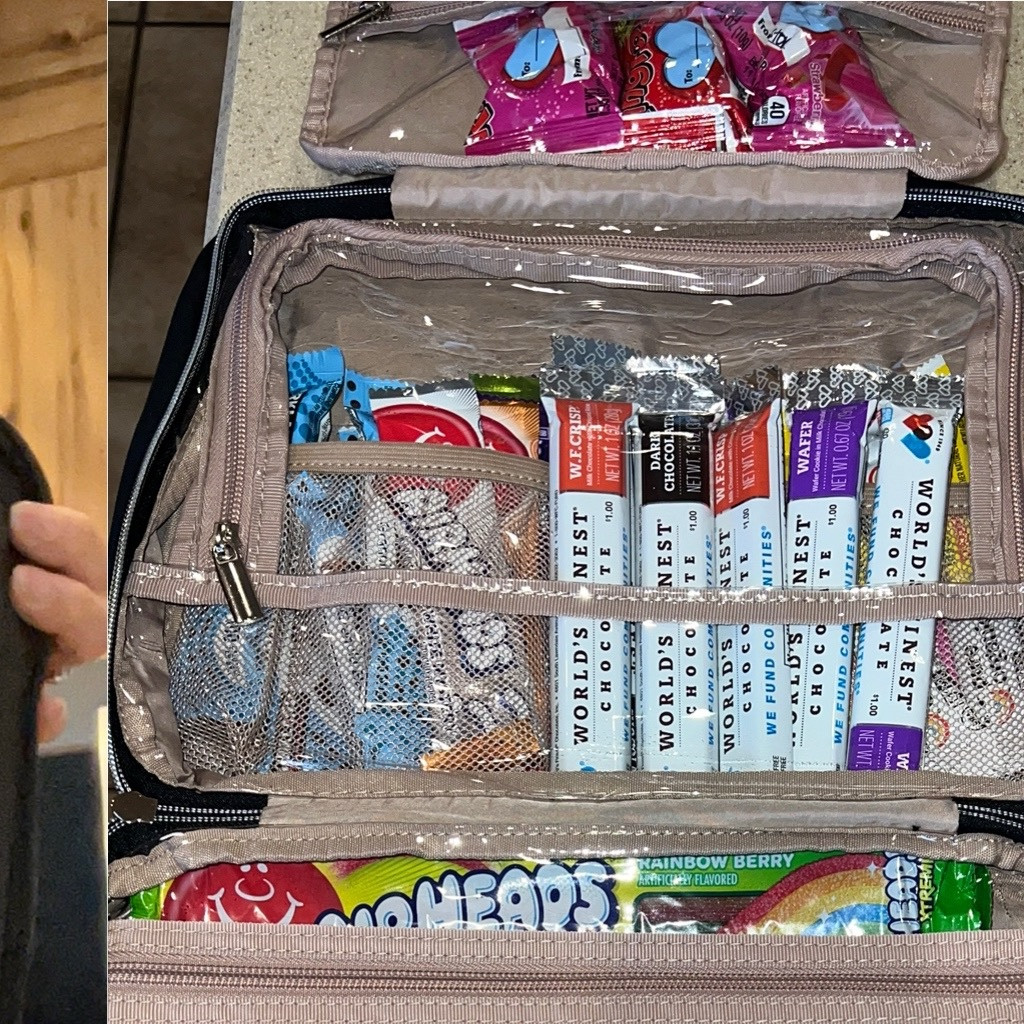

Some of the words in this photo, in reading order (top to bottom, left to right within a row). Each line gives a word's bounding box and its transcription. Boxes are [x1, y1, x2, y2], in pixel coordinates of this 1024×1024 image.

[757, 18, 773, 41] Fro
[522, 62, 531, 76] To:
[684, 69, 693, 84] To:
[809, 63, 822, 125] Strawberr
[769, 102, 784, 119] 40
[836, 420, 851, 431] OZ
[569, 405, 582, 480] W.F.CRISP
[797, 421, 813, 475] WAFER
[813, 452, 821, 473] Cookie
[605, 465, 620, 482] NET
[686, 476, 701, 492] NET
[741, 472, 755, 490] NET
[831, 475, 846, 491] NET
[605, 501, 613, 522] $1.00
[828, 504, 837, 525] $1.00
[911, 479, 933, 585] WORLD'
[897, 620, 920, 706] INEST
[573, 628, 589, 745] WORLD'S
[765, 659, 776, 703] FUND
[836, 665, 848, 712] FUND
[659, 636, 674, 752] WORLD'S
[721, 639, 735, 753] WORLD'S
[869, 695, 879, 716] $1.00
[765, 712, 776, 735] WE
[834, 720, 843, 744] WE
[858, 730, 874, 747] NET
[887, 731, 895, 750] Wafer
[639, 856, 727, 869] RAINBOW
[734, 854, 794, 869] BERRY
[694, 873, 737, 885] FLAVORED
